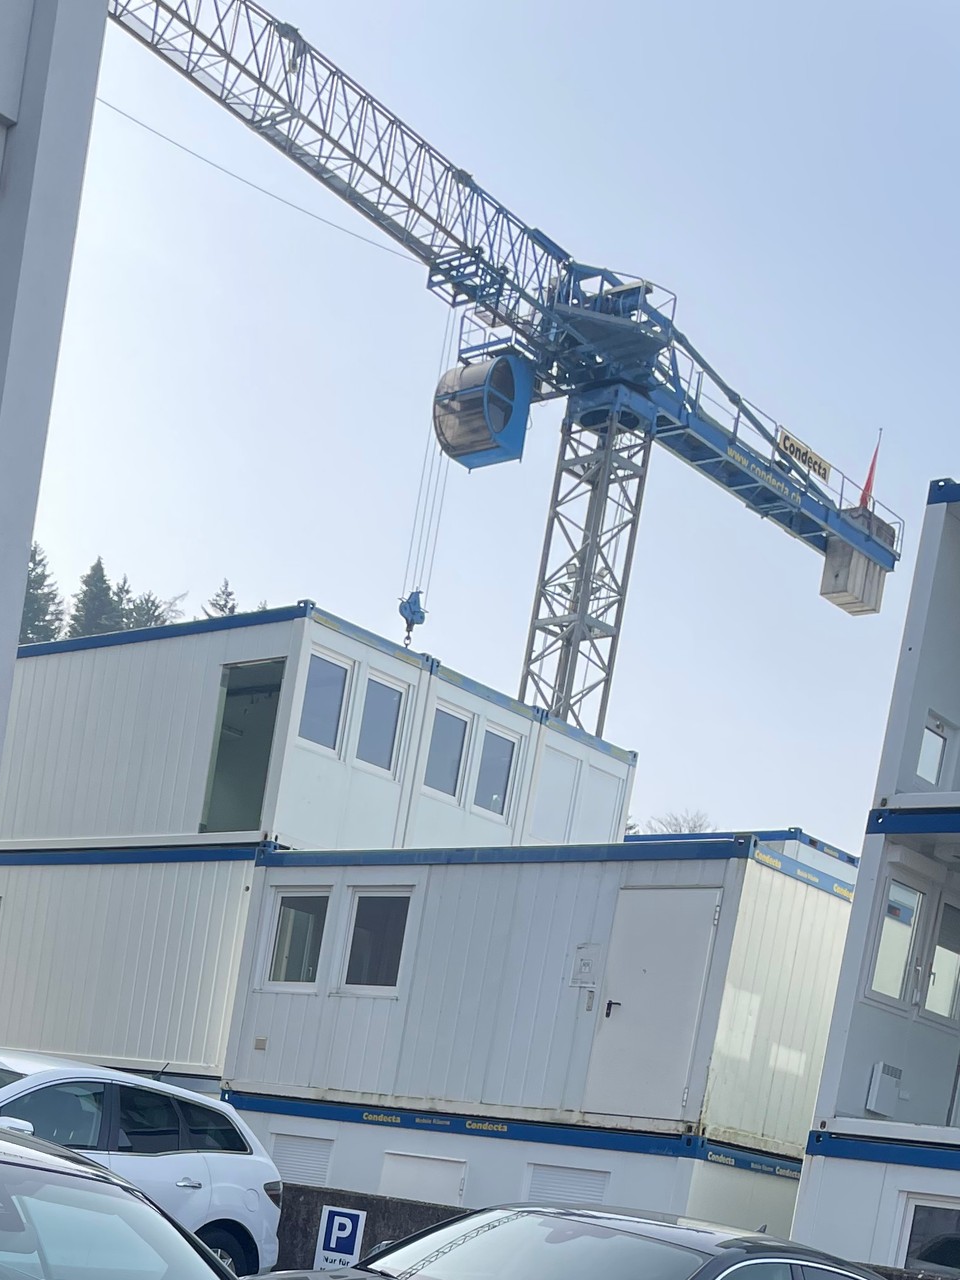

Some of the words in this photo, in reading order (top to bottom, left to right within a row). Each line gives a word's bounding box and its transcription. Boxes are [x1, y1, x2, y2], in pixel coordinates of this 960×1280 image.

[783, 434, 828, 481] Condecta
[362, 1112, 401, 1123] Condecta
[465, 1120, 508, 1132] Condecta
[329, 1215, 353, 1249] P
